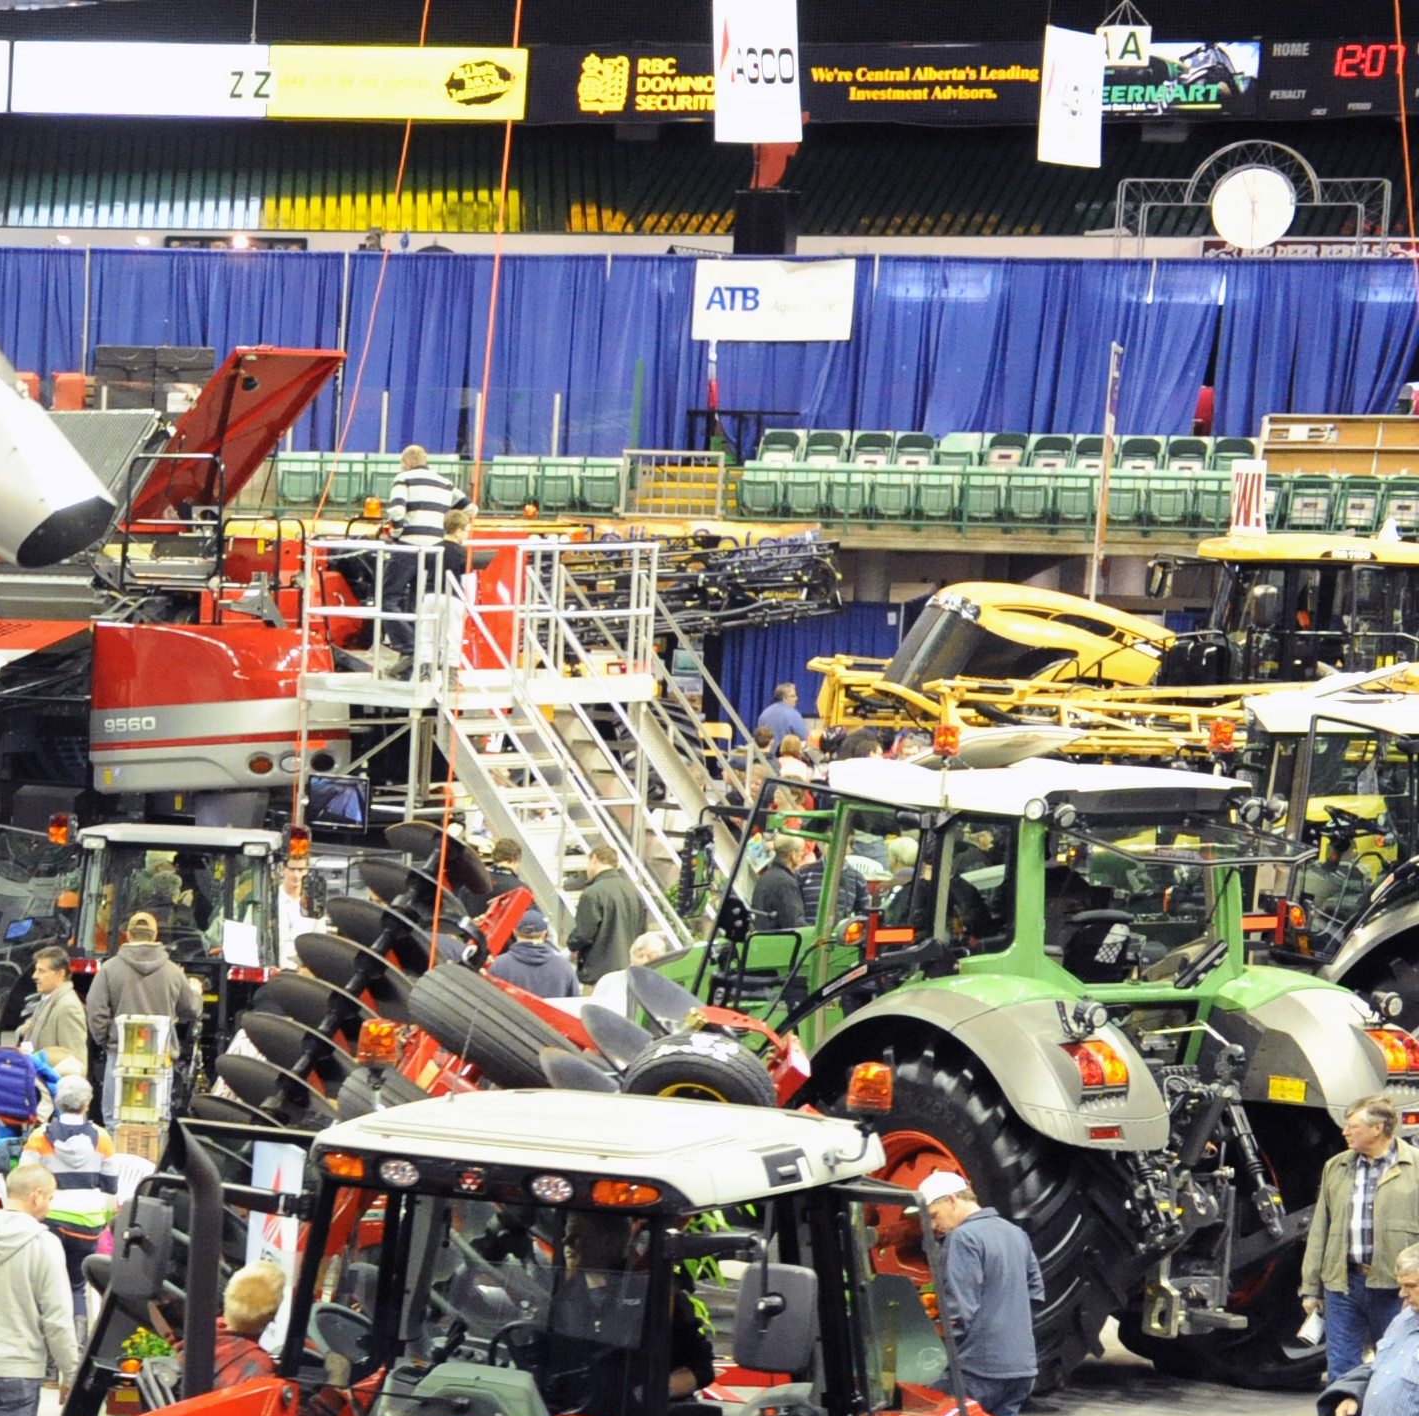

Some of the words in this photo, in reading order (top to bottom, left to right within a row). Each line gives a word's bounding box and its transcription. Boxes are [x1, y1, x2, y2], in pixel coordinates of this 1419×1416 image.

[1118, 31, 1143, 61] A
[637, 57, 677, 75] RBC
[730, 46, 796, 85] AGCO
[1334, 44, 1407, 77] 12:07
[811, 67, 853, 82] We're
[855, 67, 910, 82] Central
[912, 66, 977, 82] Alberta's
[980, 66, 1040, 82] Leading
[636, 76, 715, 92] DOMINIO
[635, 94, 715, 111] SECURITI
[848, 86, 929, 101] Investment
[931, 86, 998, 100] Advisors.
[1101, 84, 1221, 103] EERMART
[705, 286, 760, 312] ATB
[104, 716, 156, 733] 9560
